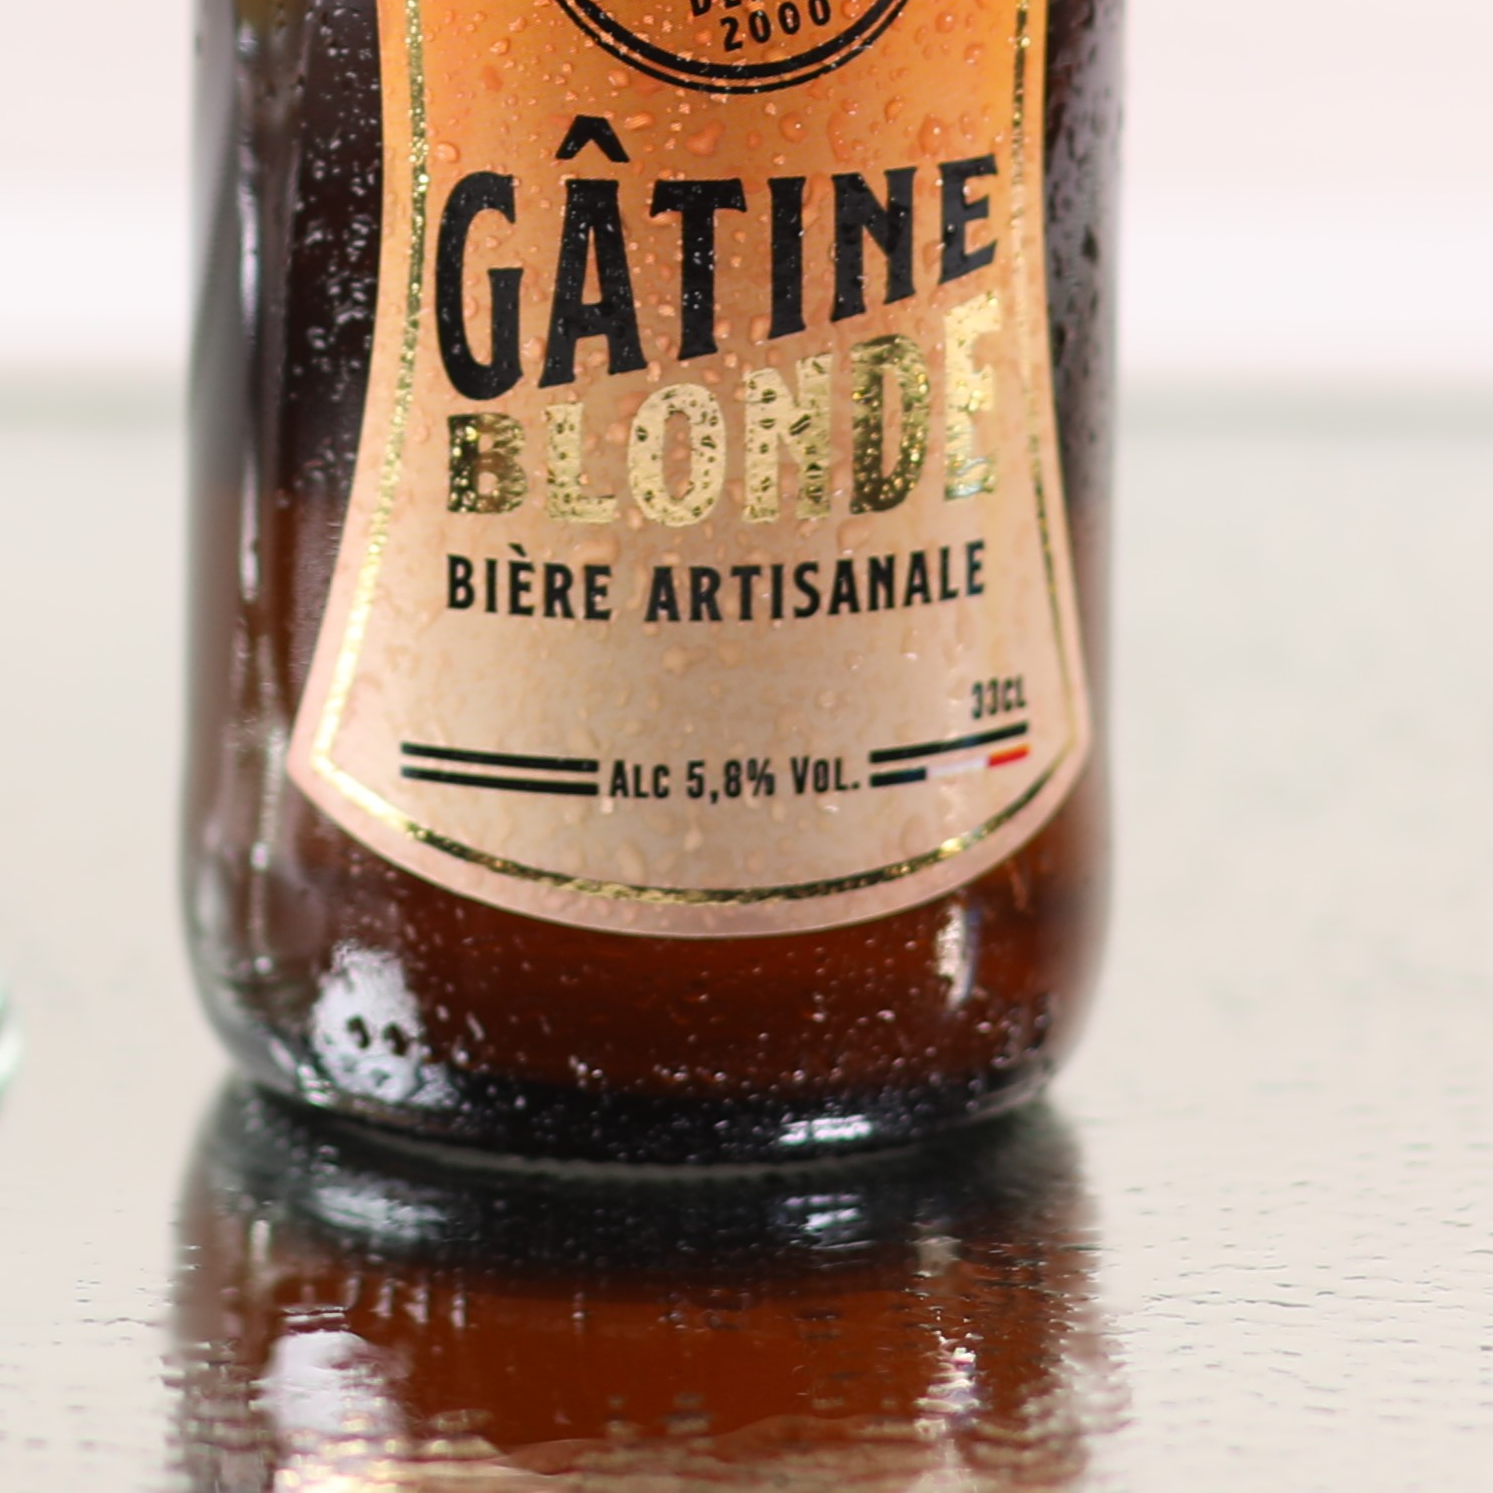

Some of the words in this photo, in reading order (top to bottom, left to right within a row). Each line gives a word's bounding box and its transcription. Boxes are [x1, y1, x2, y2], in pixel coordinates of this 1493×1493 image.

[434, 114, 1000, 402] GÂTINE
[447, 289, 1002, 528] BLONDE
[446, 543, 613, 622] BIÈRE
[644, 540, 986, 623] ARTISANALE
[687, 757, 775, 804] 5,8%
